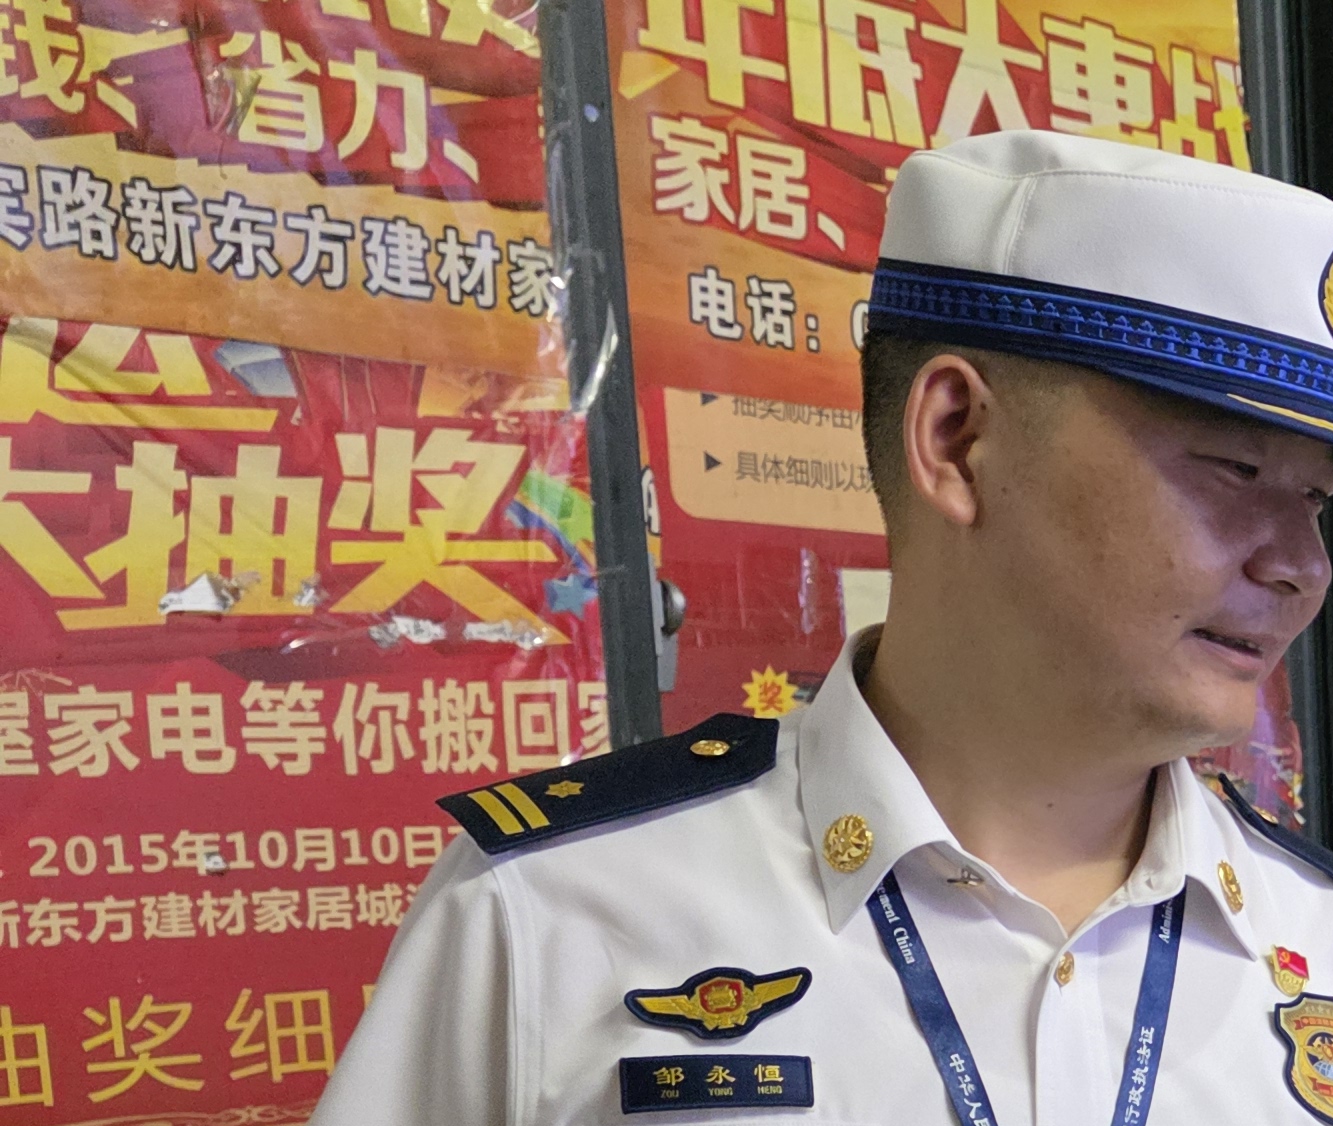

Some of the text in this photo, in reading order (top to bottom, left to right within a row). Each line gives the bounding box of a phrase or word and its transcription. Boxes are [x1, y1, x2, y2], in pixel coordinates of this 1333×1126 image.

[650, 112, 846, 253] 家居、
[733, 396, 861, 430] 抽奖顺序由
[28, 826, 460, 877] 2015年10月10日
[0, 883, 420, 948] 东方建材家居城
[893, 926, 915, 965] China
